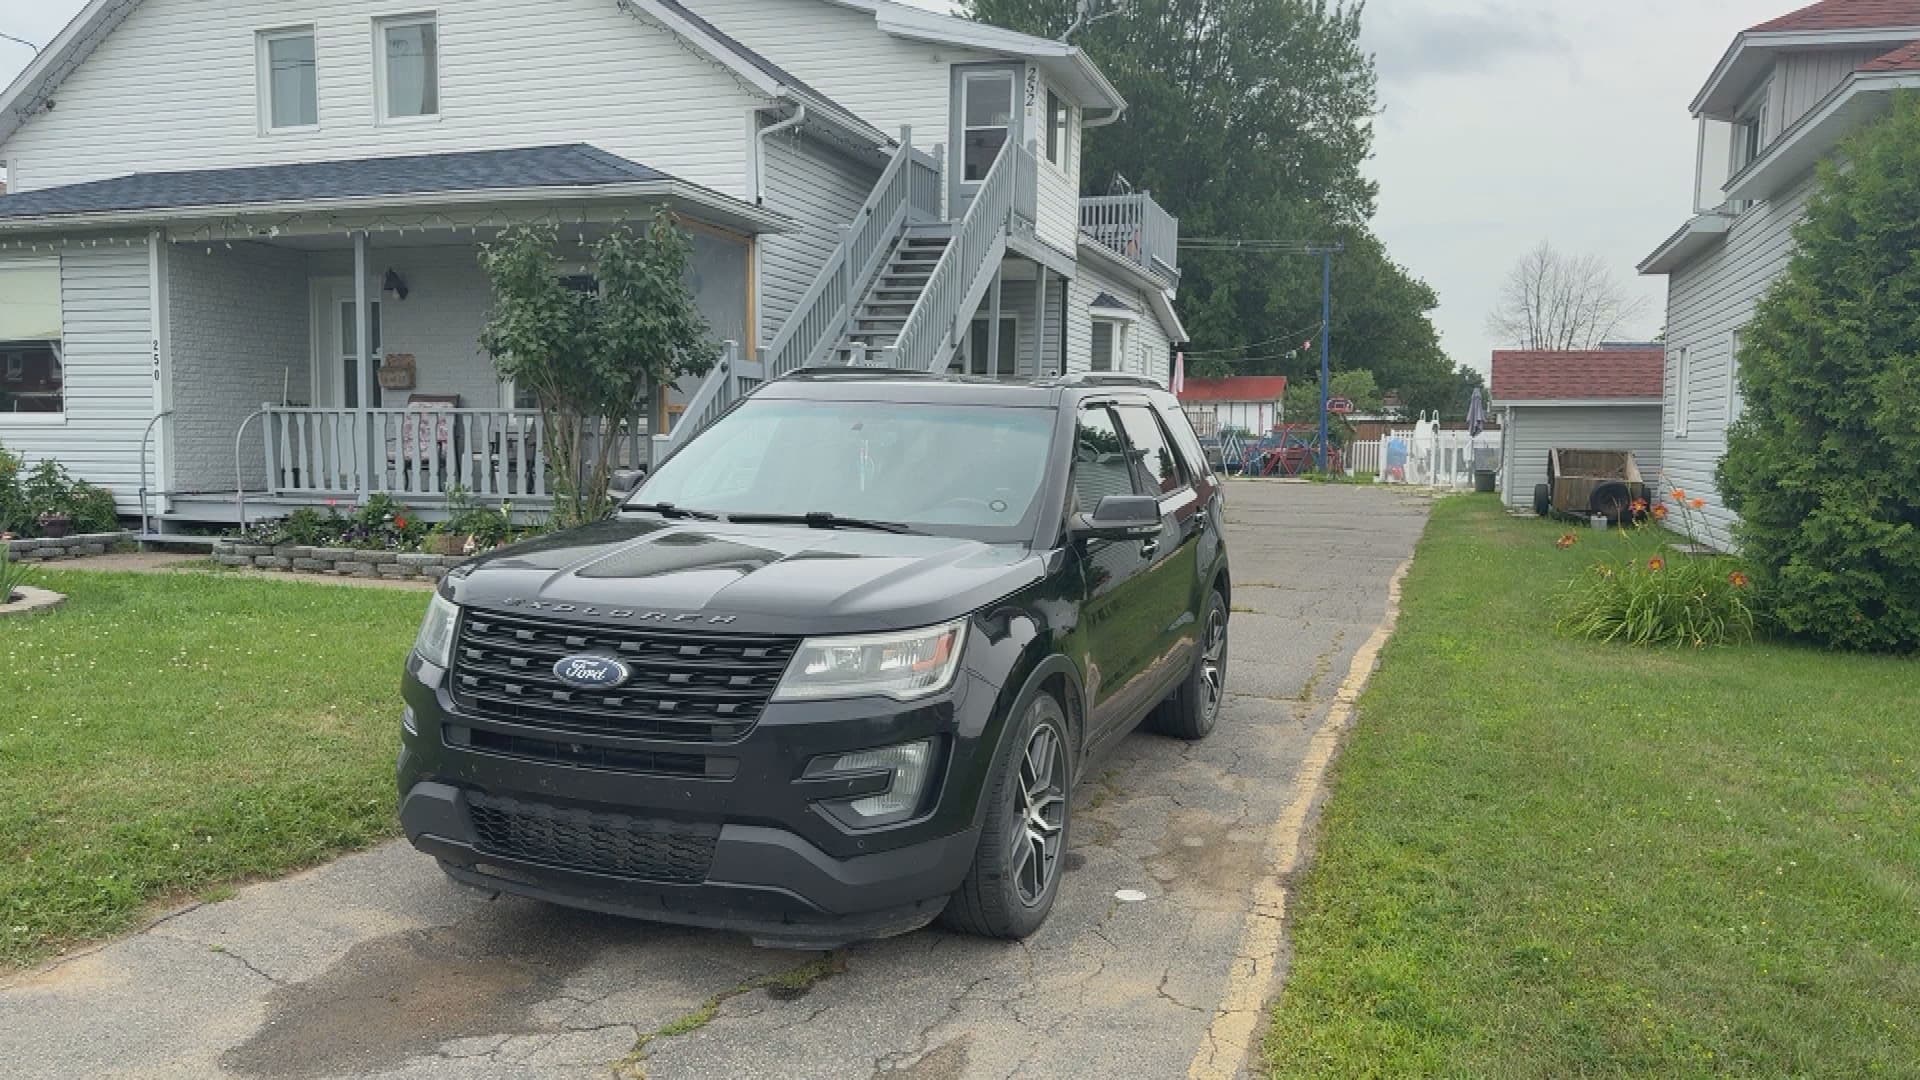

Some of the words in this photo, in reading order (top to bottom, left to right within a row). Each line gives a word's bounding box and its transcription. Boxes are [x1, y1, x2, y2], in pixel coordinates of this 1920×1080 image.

[1026, 67, 1036, 107] 252
[152, 339, 160, 381] 250
[503, 597, 738, 625] EXPLORER
[565, 659, 609, 681] Ford
